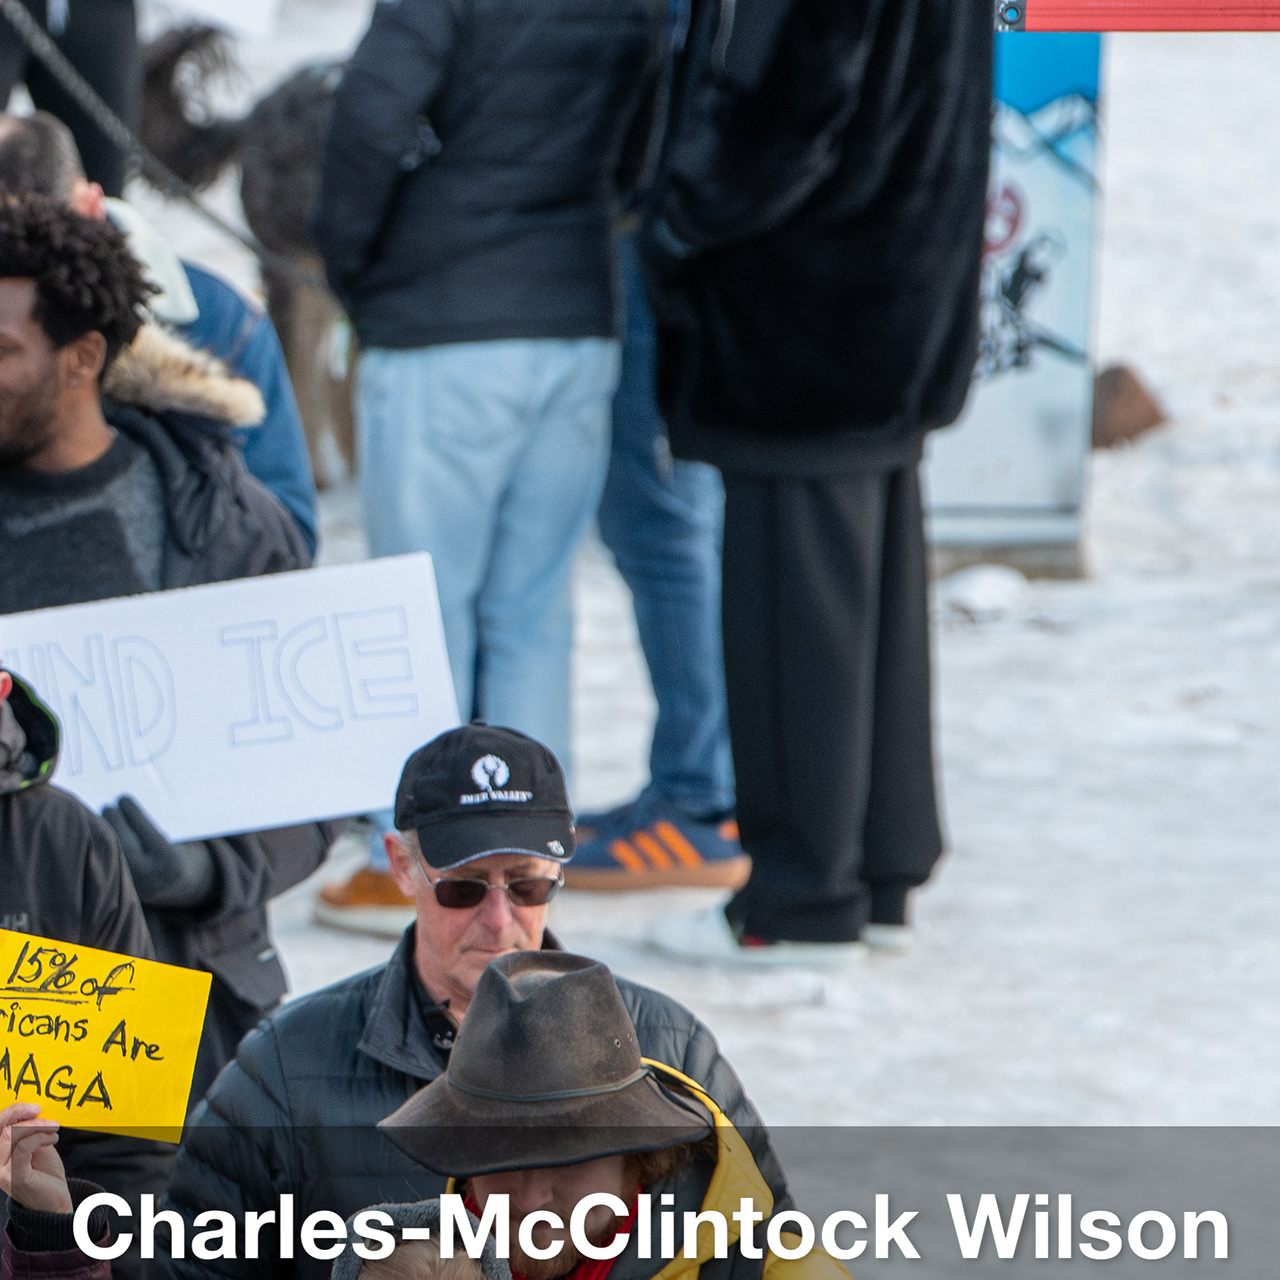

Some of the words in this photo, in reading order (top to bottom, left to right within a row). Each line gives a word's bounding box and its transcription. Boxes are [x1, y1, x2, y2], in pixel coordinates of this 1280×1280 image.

[216, 604, 419, 748] ICE
[7, 940, 79, 991] 15%
[80, 960, 136, 1011] of
[102, 1019, 165, 1062] Are
